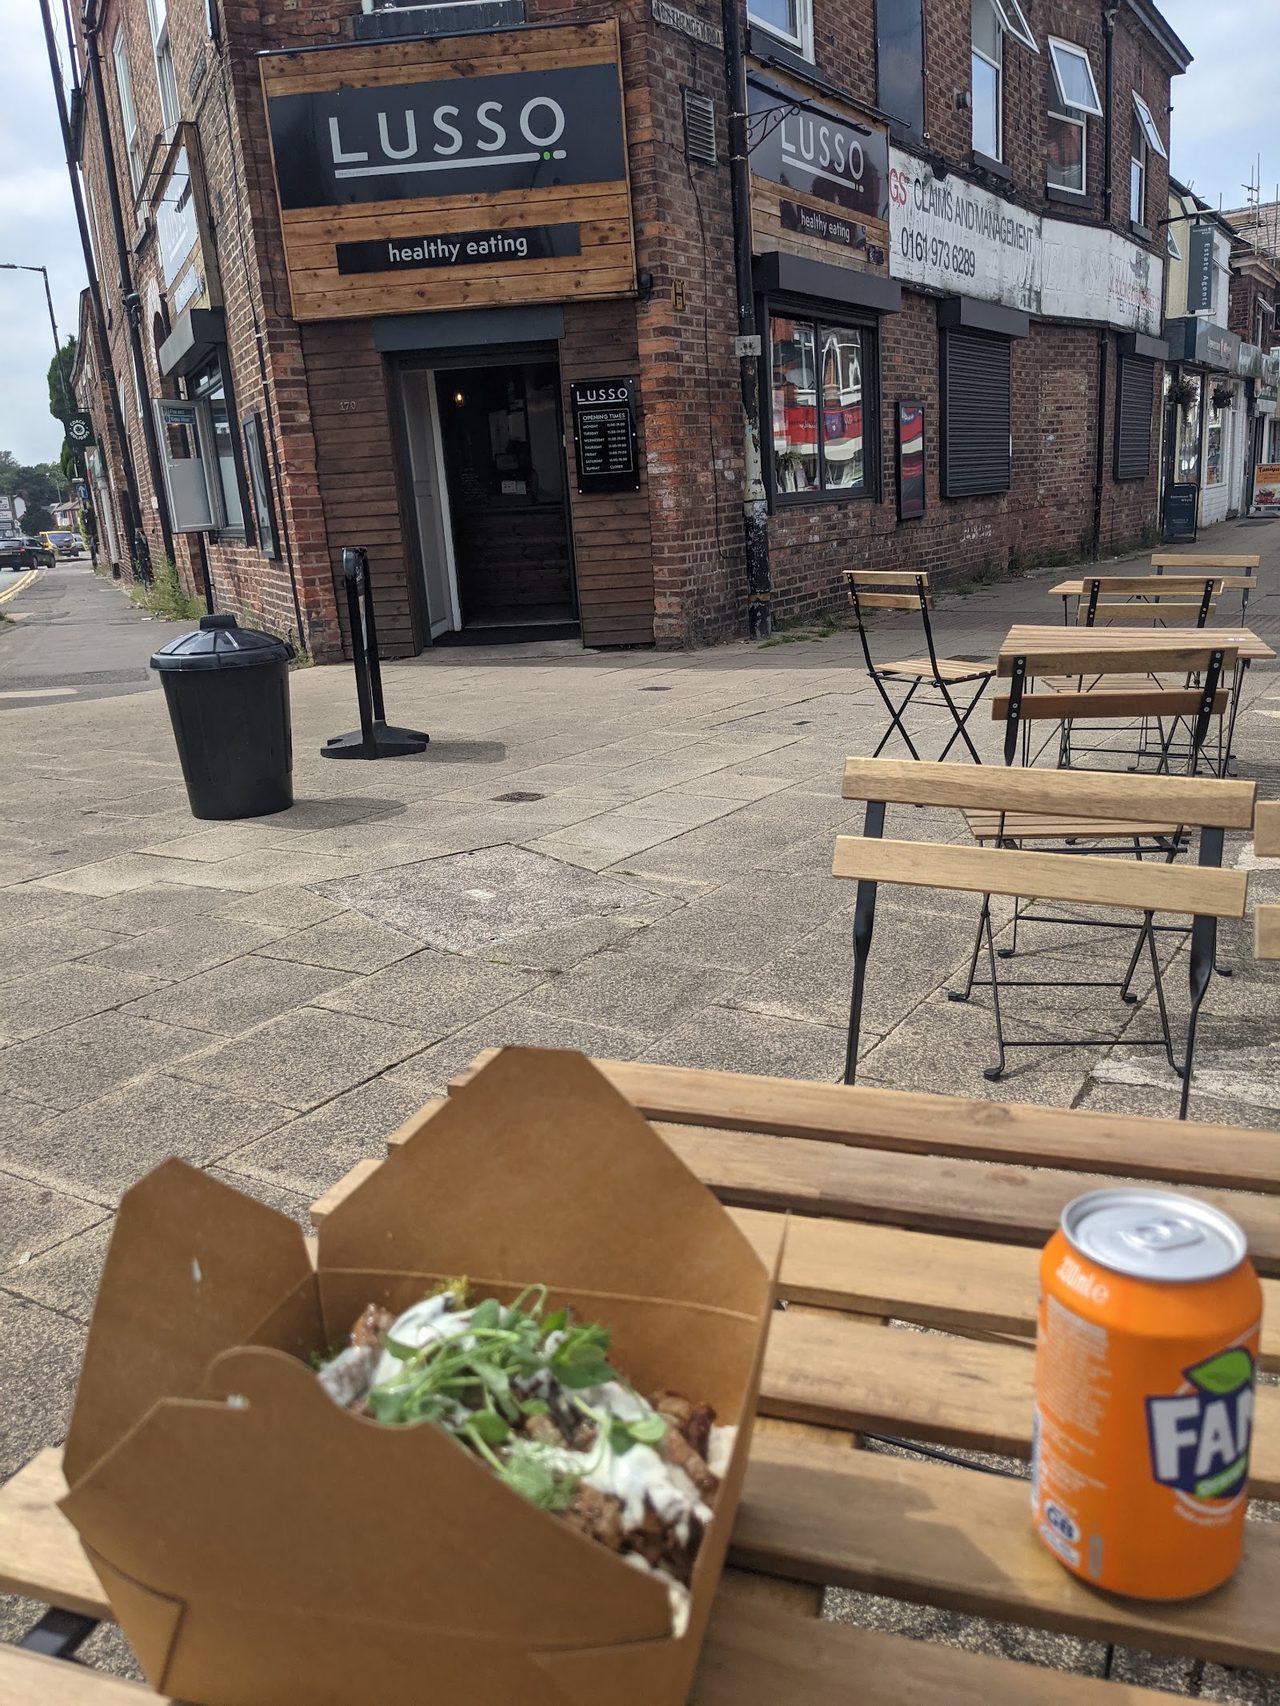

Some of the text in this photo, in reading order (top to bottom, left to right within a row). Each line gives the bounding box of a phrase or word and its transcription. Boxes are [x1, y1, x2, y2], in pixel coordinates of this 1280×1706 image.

[329, 97, 565, 163] LUSSO
[780, 108, 864, 180] LUSSO
[801, 209, 850, 243] healthy eating
[889, 168, 1033, 253] GS CLAIMS AND MANAGEMENT
[388, 234, 527, 262] healthy eating
[901, 227, 928, 262] 0161
[931, 237, 950, 270] 973
[952, 245, 976, 277] 6289
[1201, 243, 1211, 306] Estate Agents
[576, 388, 628, 402] LUSSO
